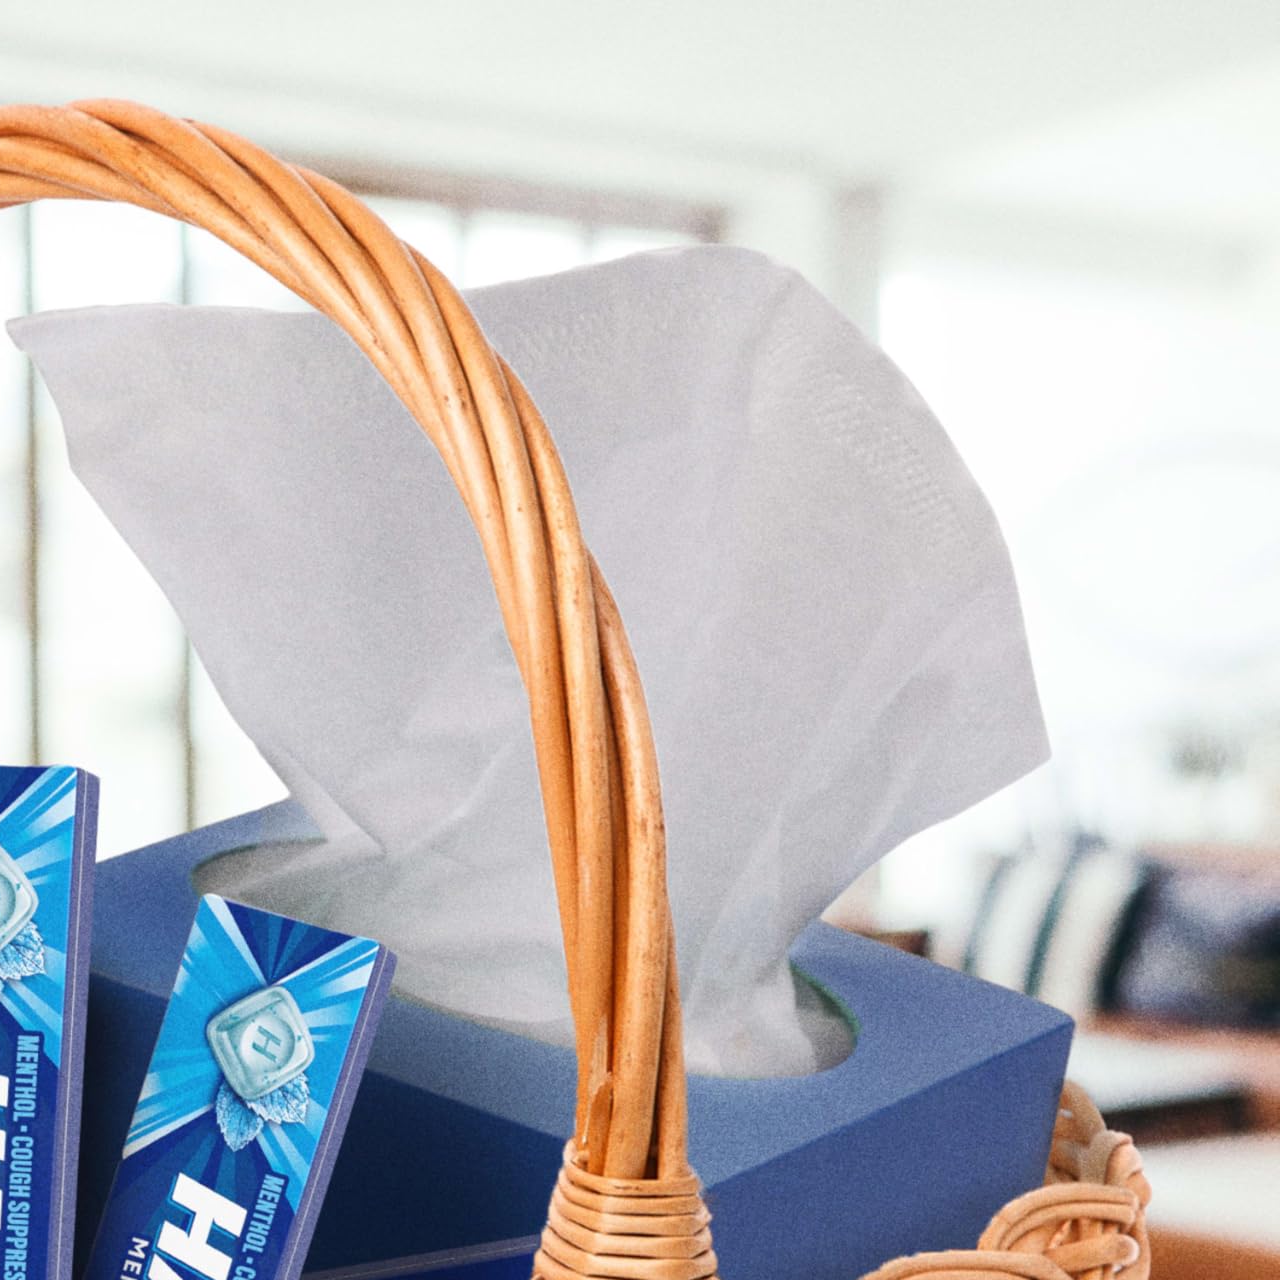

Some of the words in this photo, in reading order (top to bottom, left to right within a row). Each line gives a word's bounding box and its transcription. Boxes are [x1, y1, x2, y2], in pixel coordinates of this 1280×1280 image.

[13, 1035, 40, 1122] MENTHOL
[252, 1025, 282, 1062] H
[9, 1136, 34, 1198] COUGH
[242, 1174, 285, 1253] MENTHOL
